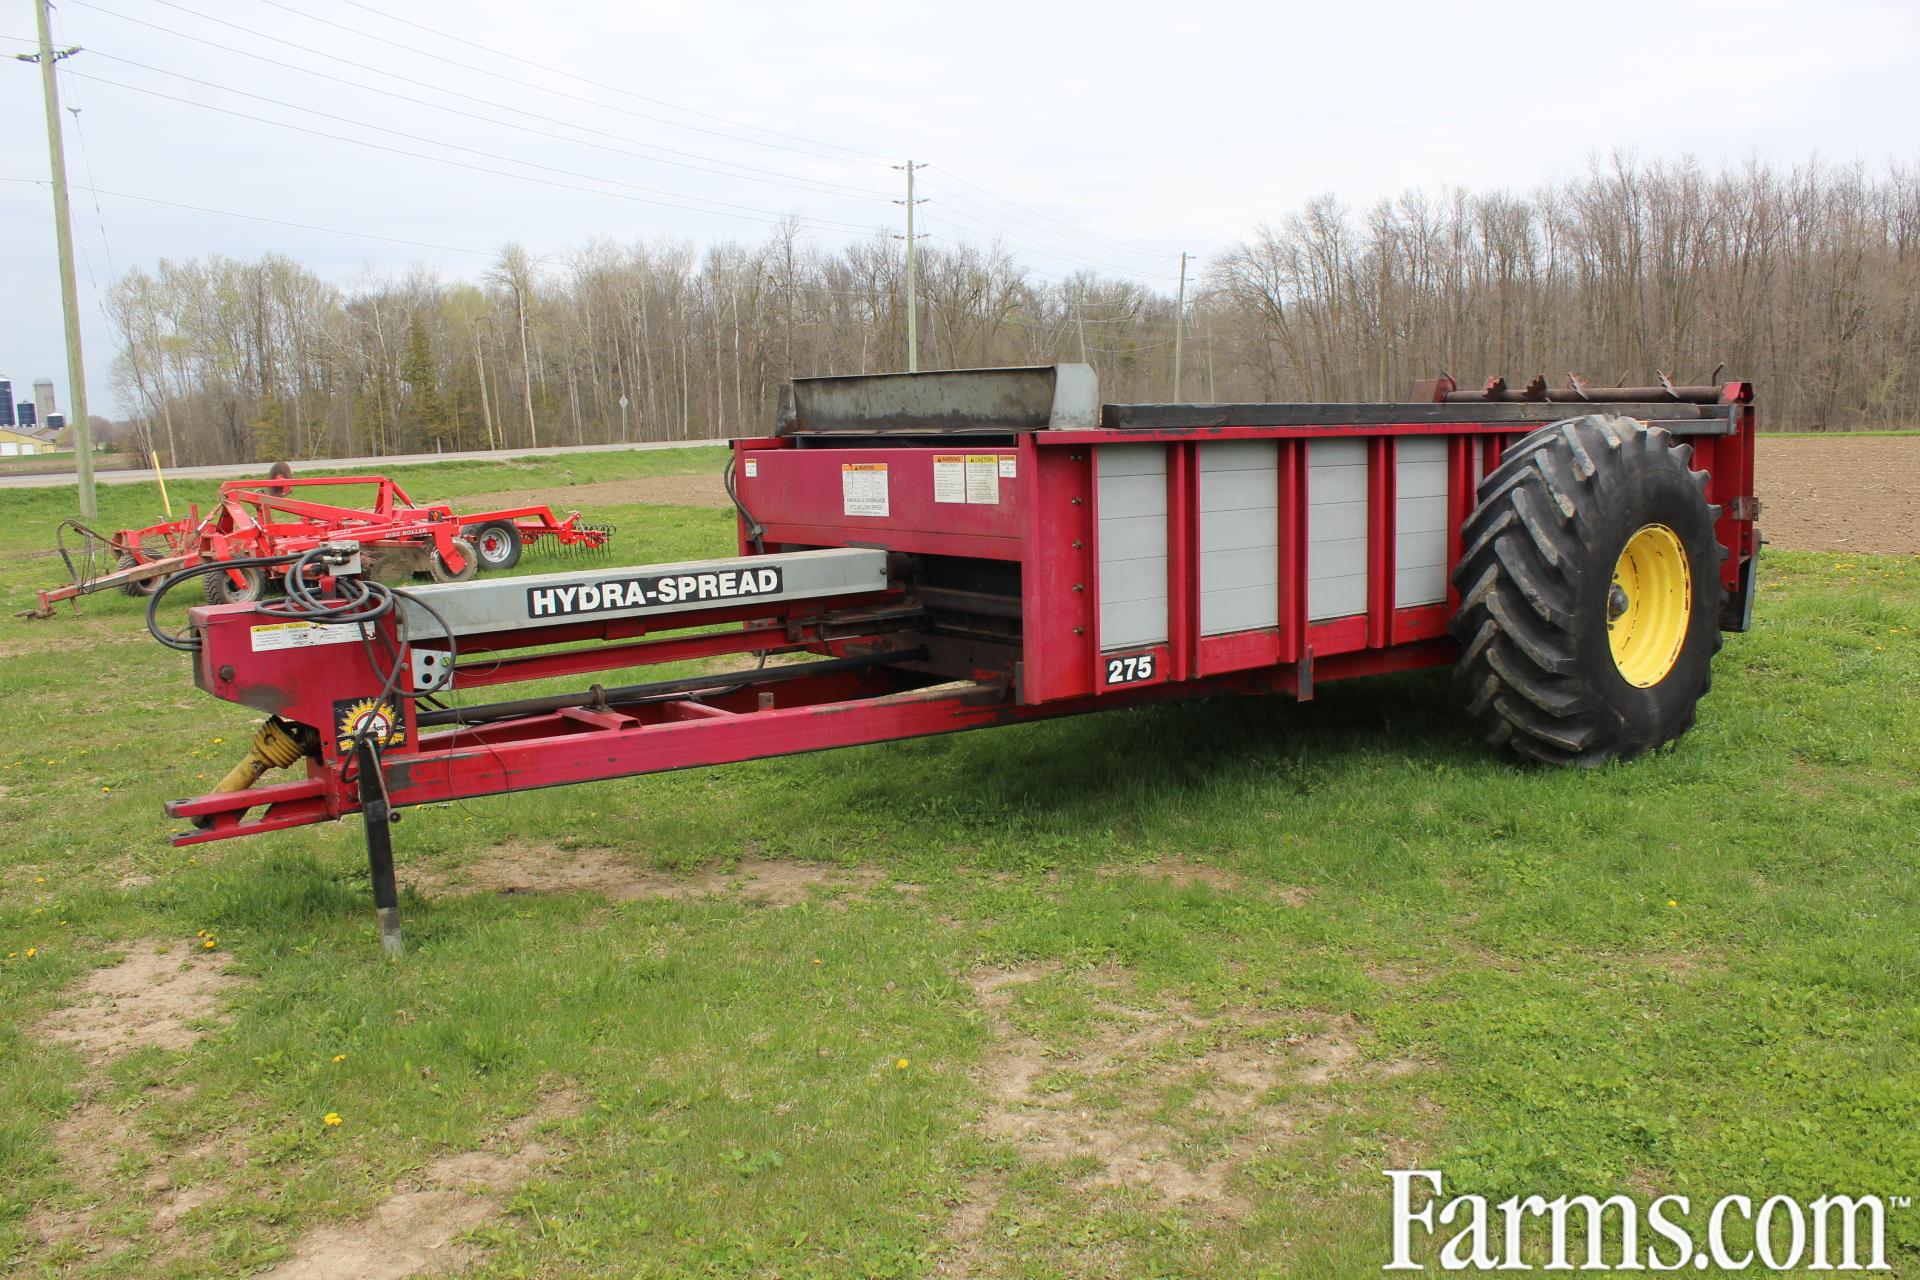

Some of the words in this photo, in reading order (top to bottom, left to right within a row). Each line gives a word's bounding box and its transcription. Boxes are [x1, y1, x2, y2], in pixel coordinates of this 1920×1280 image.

[402, 528, 428, 537] ROLLER
[532, 569, 778, 615] HYDRA-SPREAD
[1109, 656, 1152, 684] 275
